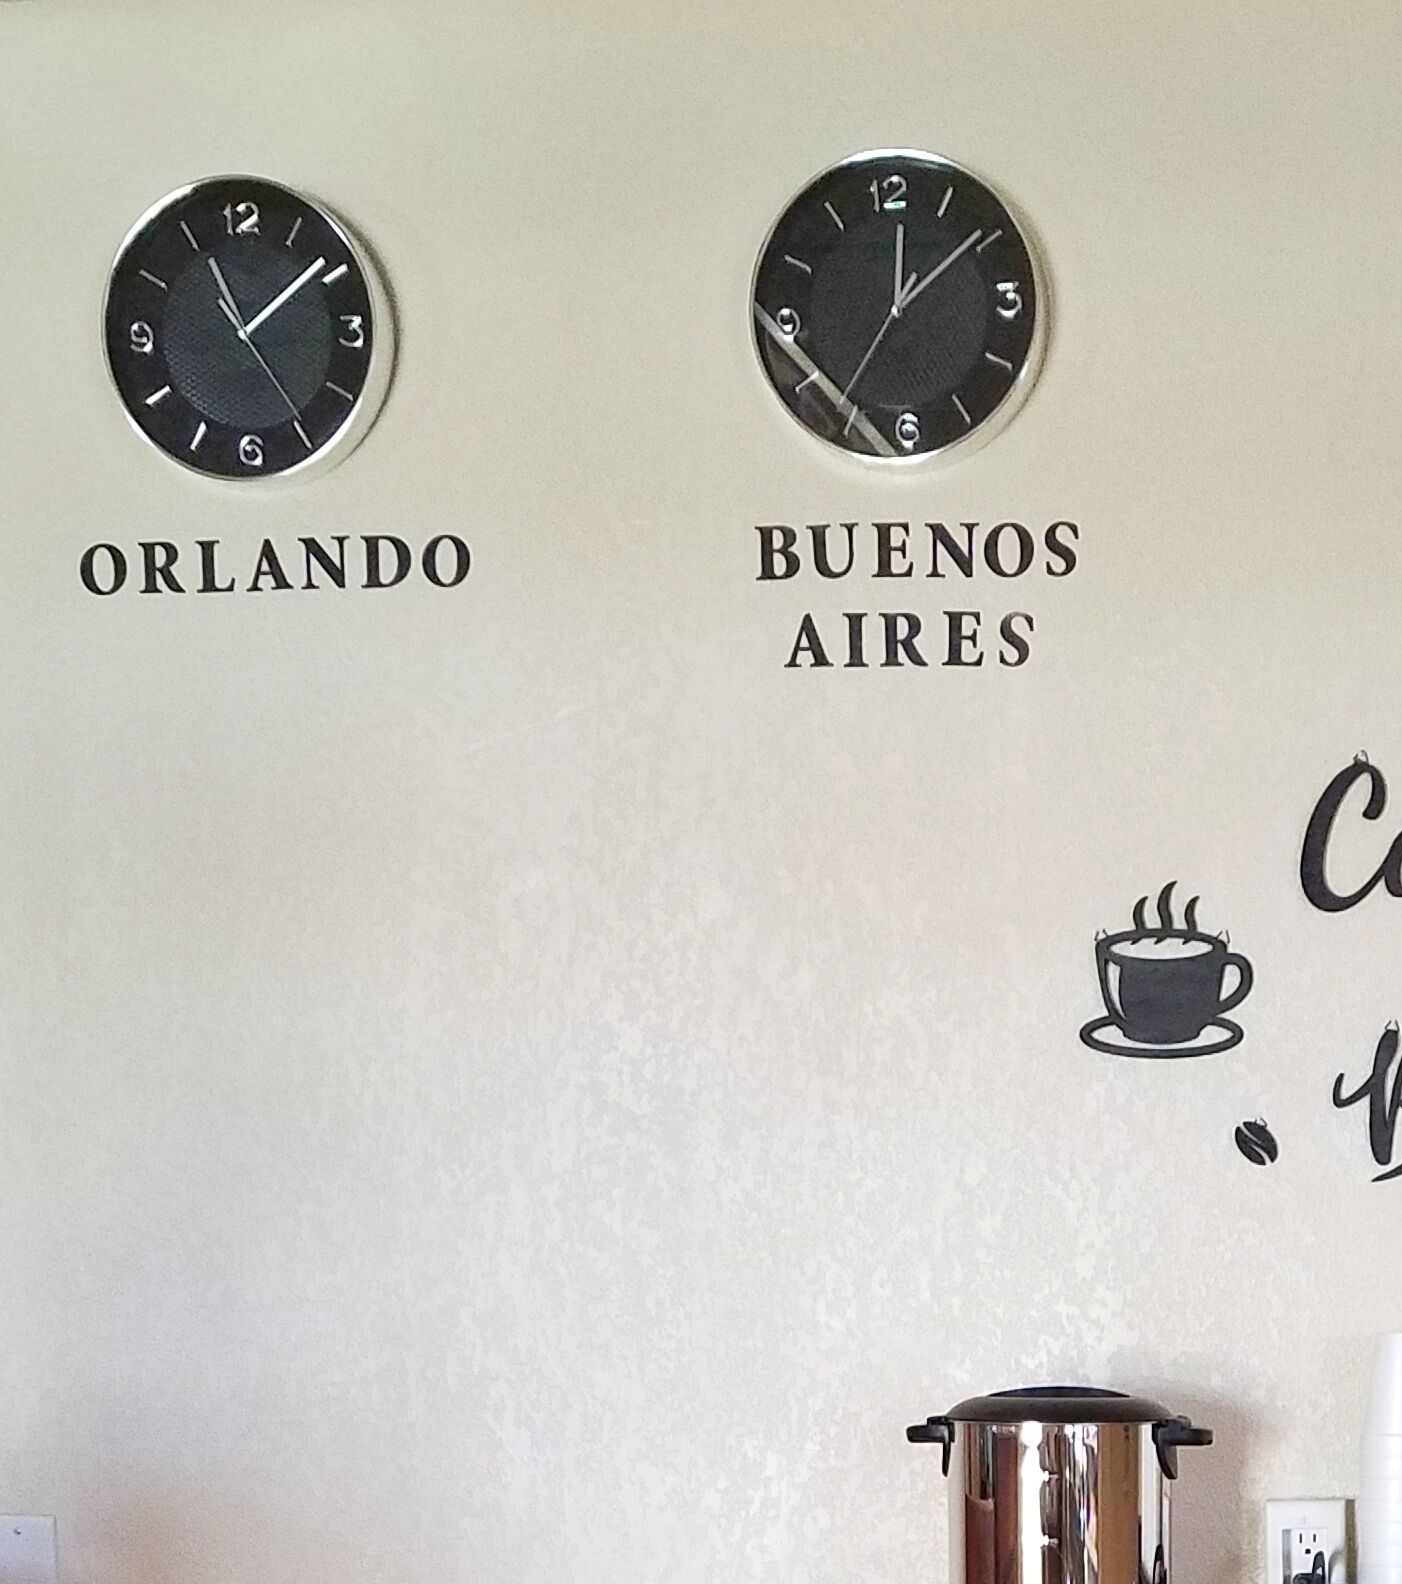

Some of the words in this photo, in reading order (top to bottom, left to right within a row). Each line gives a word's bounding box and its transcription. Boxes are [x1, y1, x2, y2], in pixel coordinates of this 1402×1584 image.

[870, 175, 907, 212] 12
[223, 202, 260, 235] 12
[996, 281, 1022, 319] 3
[130, 321, 153, 353] 9
[339, 314, 363, 348] 3
[776, 308, 801, 343] 9
[895, 413, 920, 449] 6
[238, 435, 264, 466] 6
[80, 534, 471, 596] ORLANDO
[754, 521, 1080, 581] BUENOS
[784, 610, 1035, 668] AIRES
